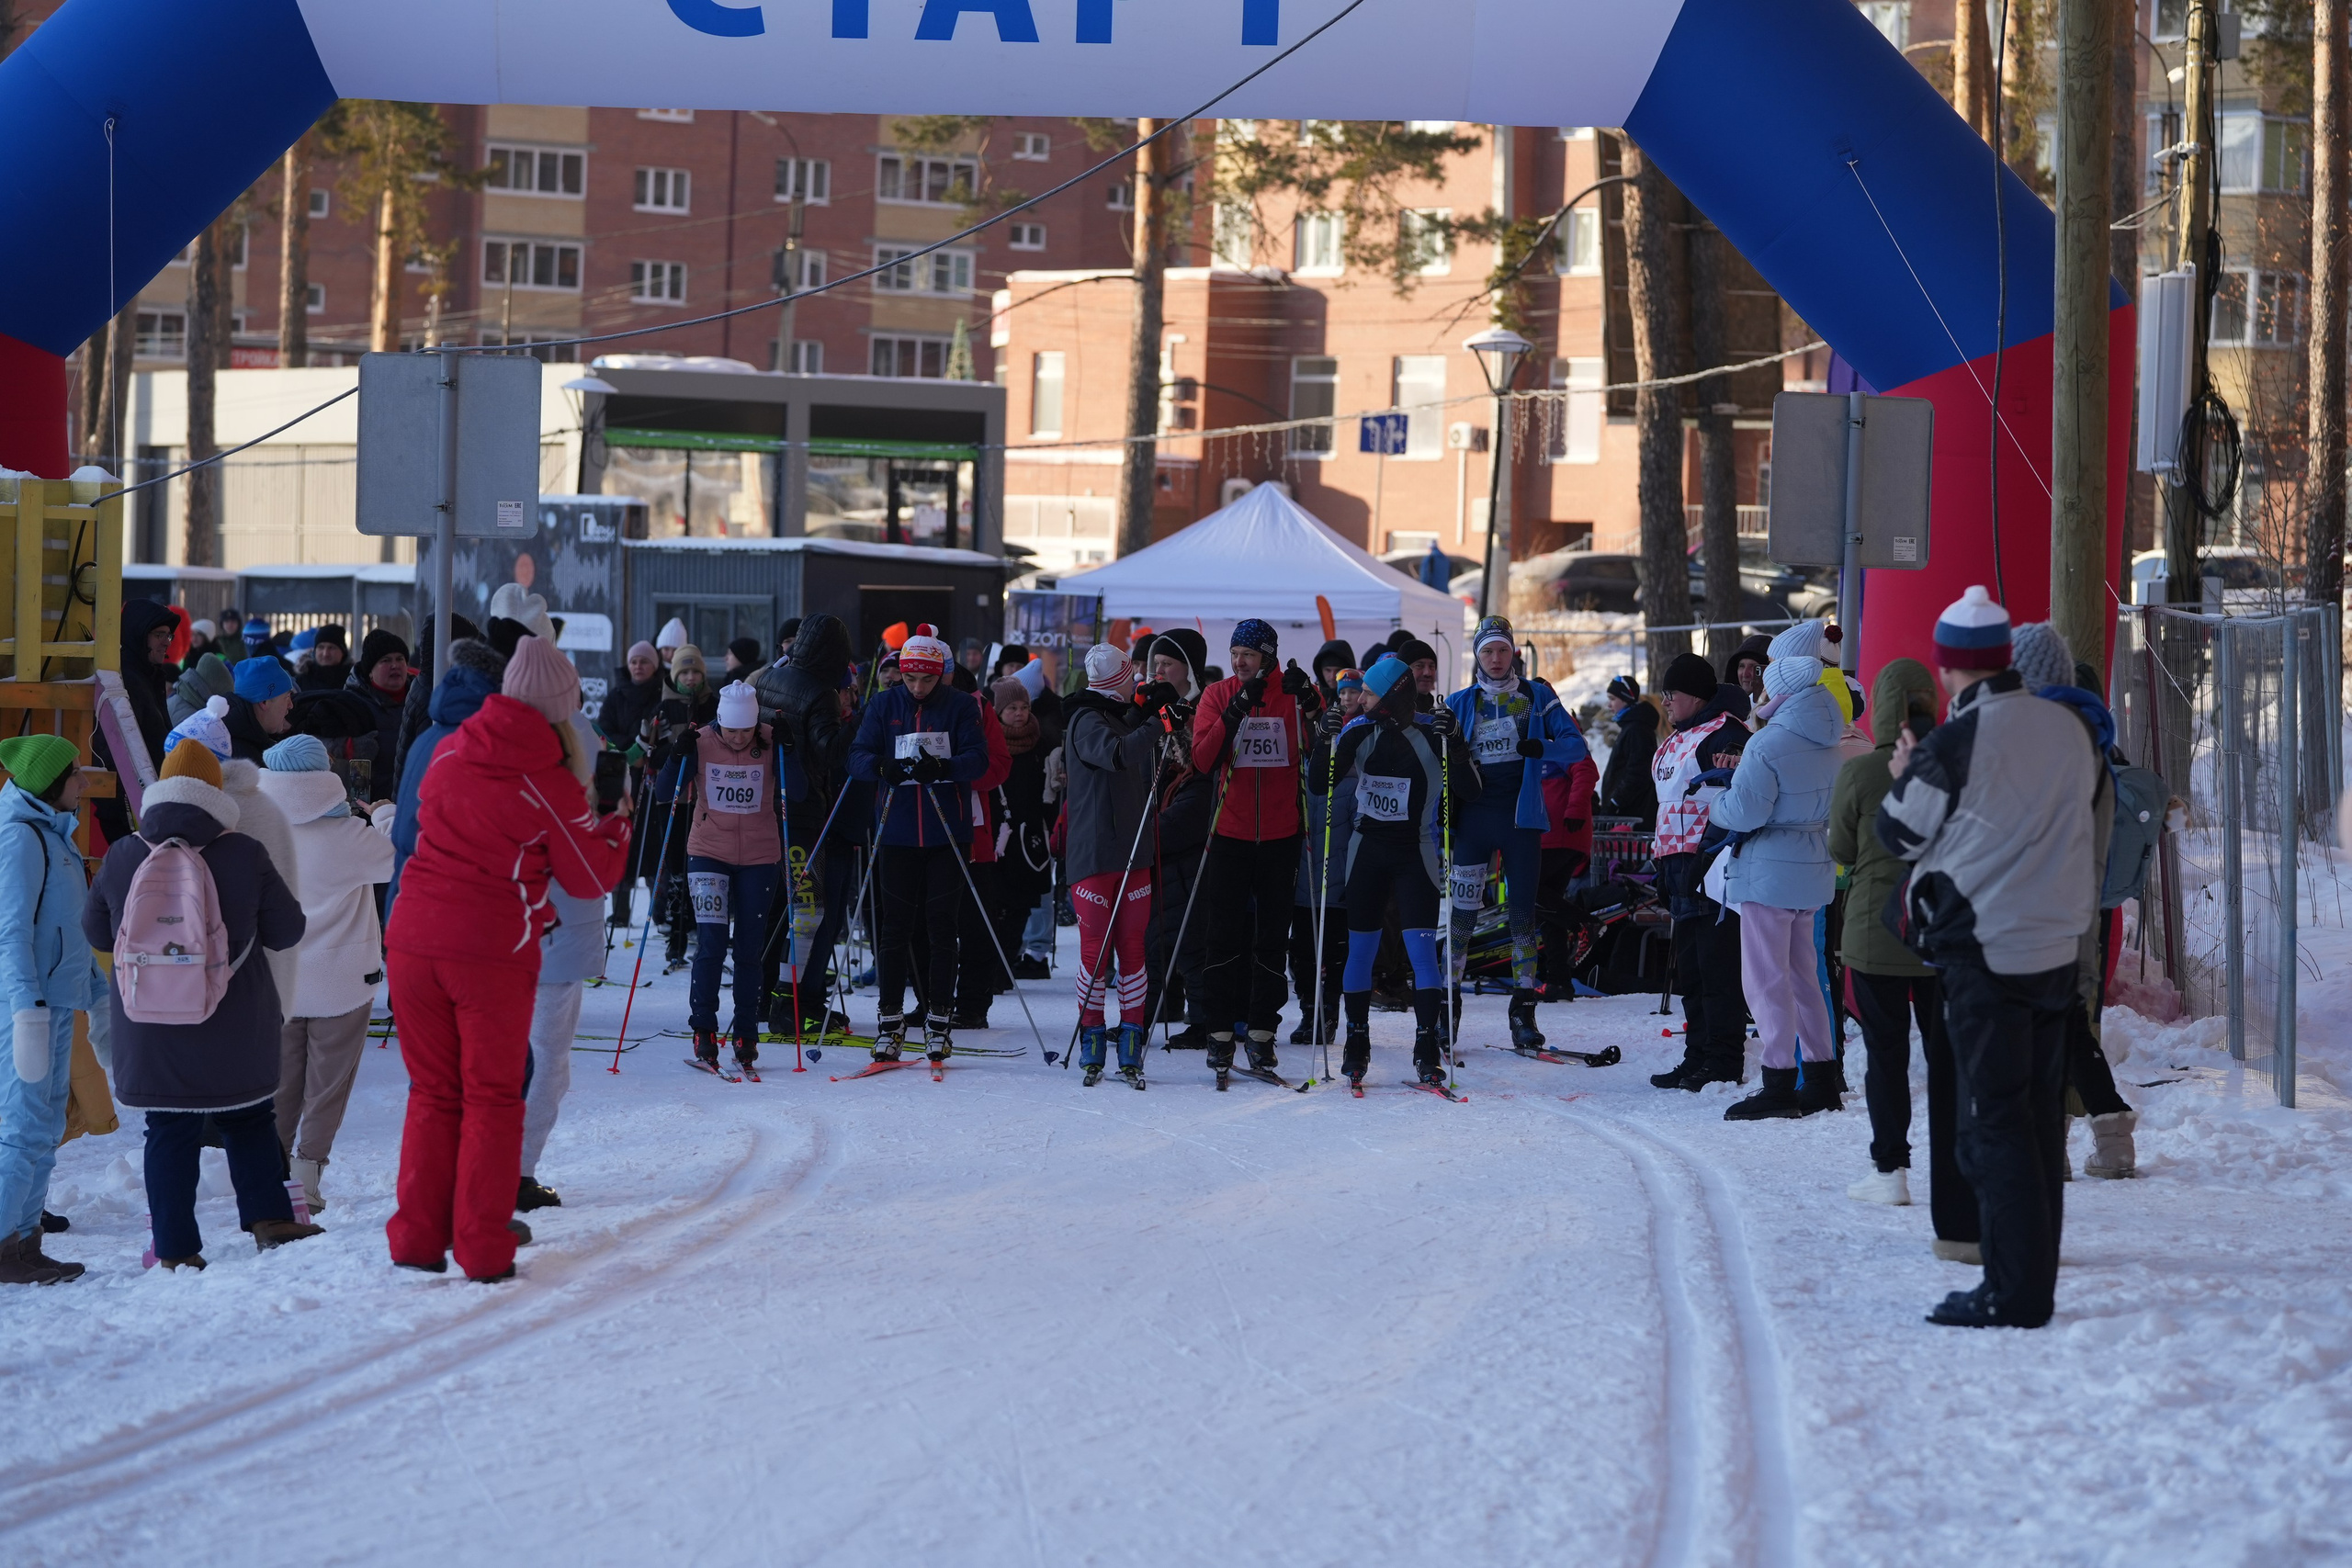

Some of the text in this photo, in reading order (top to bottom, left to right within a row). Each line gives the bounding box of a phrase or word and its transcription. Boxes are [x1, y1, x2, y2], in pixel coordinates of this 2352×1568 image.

[1242, 739, 1280, 755] 7561
[1477, 738, 1510, 753] 7087
[716, 786, 754, 803] 7069
[1366, 791, 1398, 813] 7009
[788, 845, 816, 918] CRAFT
[1452, 881, 1481, 898] 7087
[1075, 886, 1109, 908] LUKOIL
[767, 1037, 842, 1046] FISCHER
